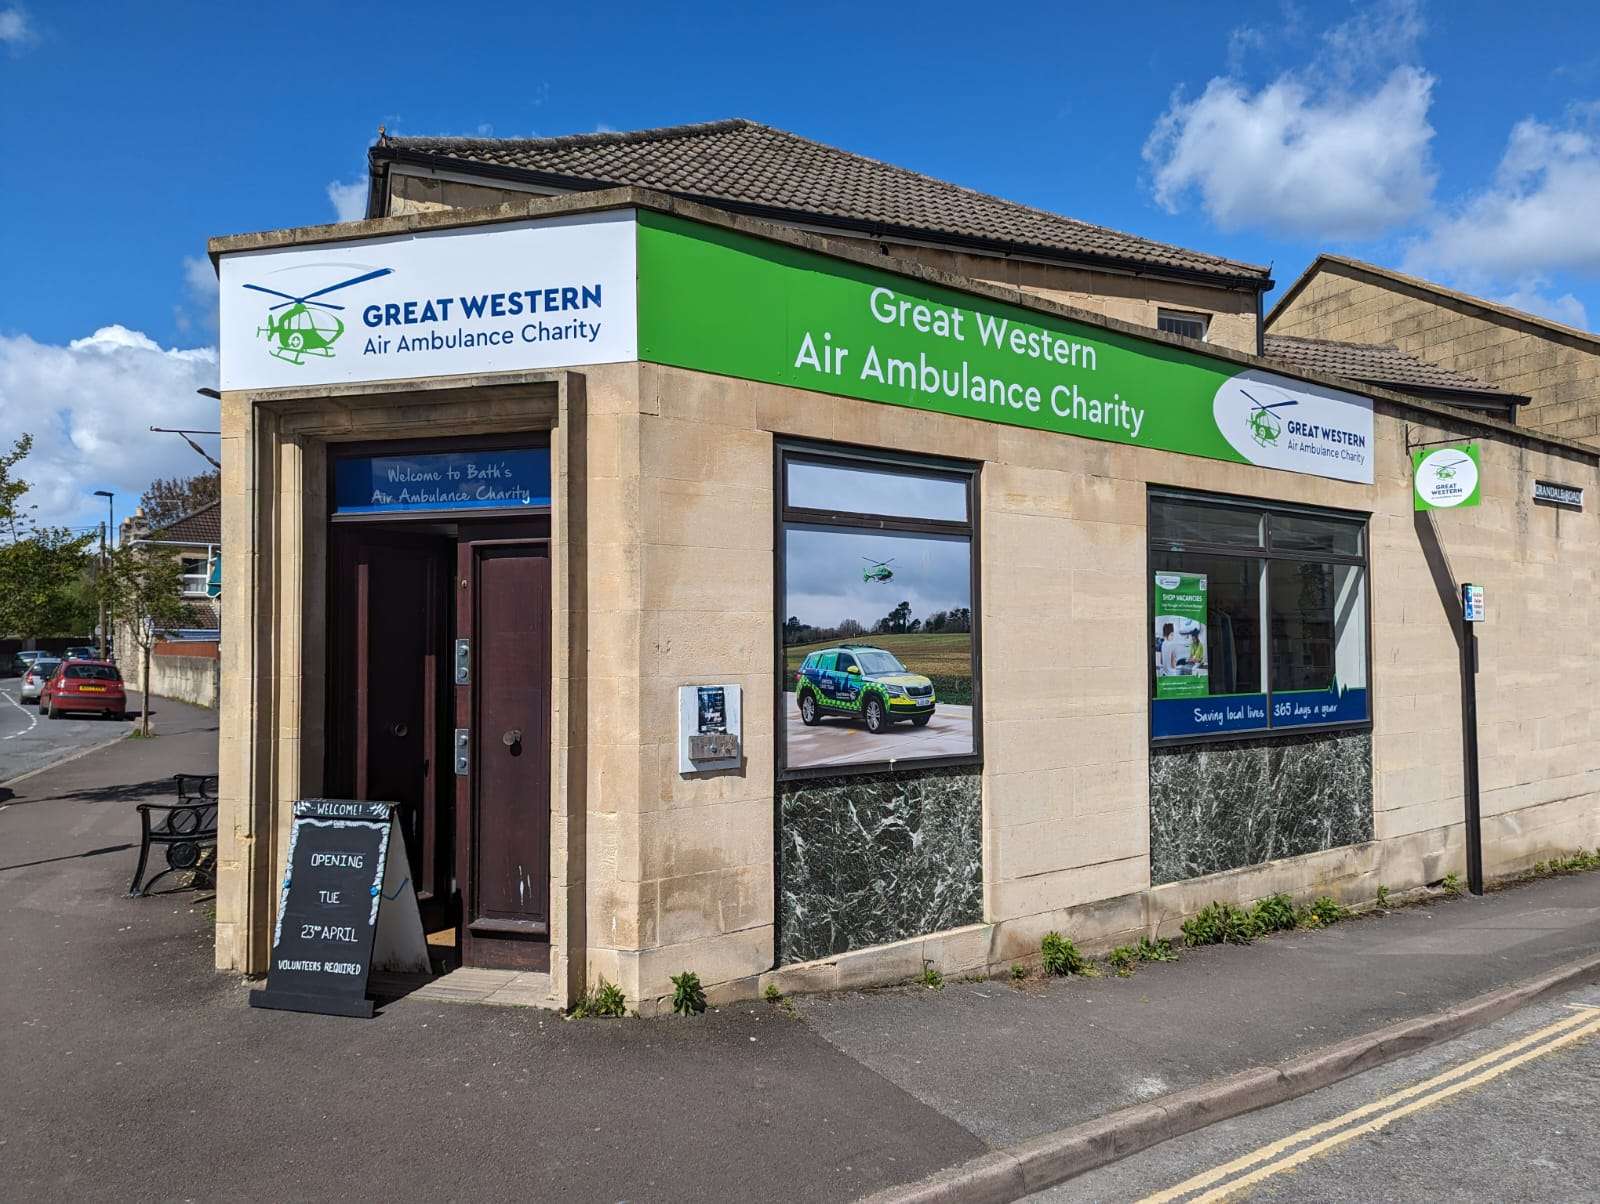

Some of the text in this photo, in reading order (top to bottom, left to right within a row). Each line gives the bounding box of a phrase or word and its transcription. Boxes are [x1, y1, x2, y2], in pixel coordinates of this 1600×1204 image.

[363, 284, 602, 328] GREAT WESTERN
[363, 319, 602, 355] Air Ambulance Charity
[870, 286, 1096, 370] Great Western
[795, 331, 1144, 438] Air Ambulance Charity
[1287, 420, 1365, 448] GREAT WESTERN
[1287, 439, 1365, 465] Air Ambulance Charity
[387, 462, 513, 482] Welcome to Bath's
[371, 483, 531, 504] Air Ambulance Charity
[1194, 702, 1338, 725] Saving local lives 365 days a year
[317, 803, 362, 815] WELCOME!
[311, 854, 363, 868] OPENING
[319, 891, 340, 904] TUE
[321, 926, 358, 942] APRIL
[278, 960, 361, 975] VOLUNTEERS REQUIRED
